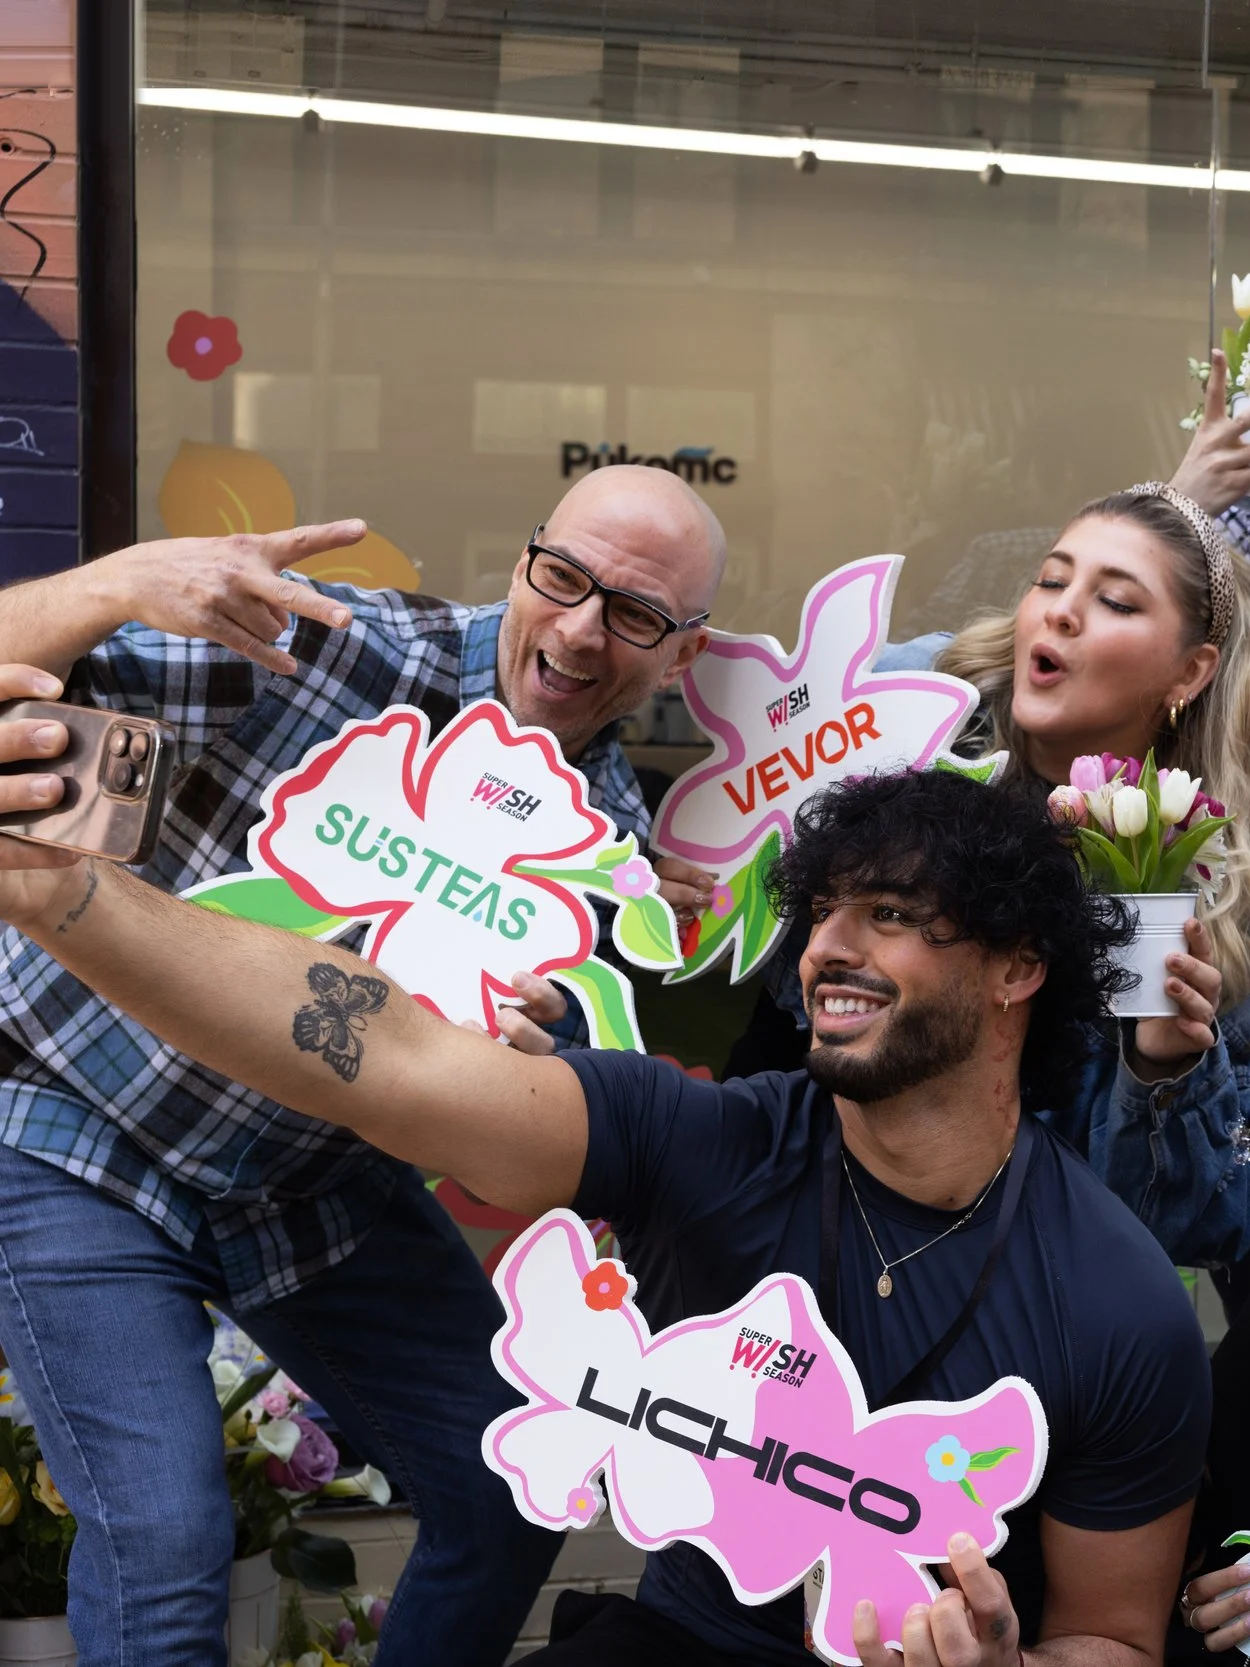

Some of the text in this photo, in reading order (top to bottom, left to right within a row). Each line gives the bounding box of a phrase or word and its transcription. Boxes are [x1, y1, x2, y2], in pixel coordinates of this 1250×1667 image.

[766, 698, 783, 713] SUPER
[789, 701, 810, 719] SEASON
[722, 702, 882, 815] VEVOR
[482, 772, 508, 789] SUPER
[496, 803, 528, 822] SEASON
[315, 803, 536, 940] SUSTEAS
[739, 1327, 773, 1346] SUPER
[762, 1366, 804, 1388] SEASON
[575, 1366, 922, 1535] LICHICO
